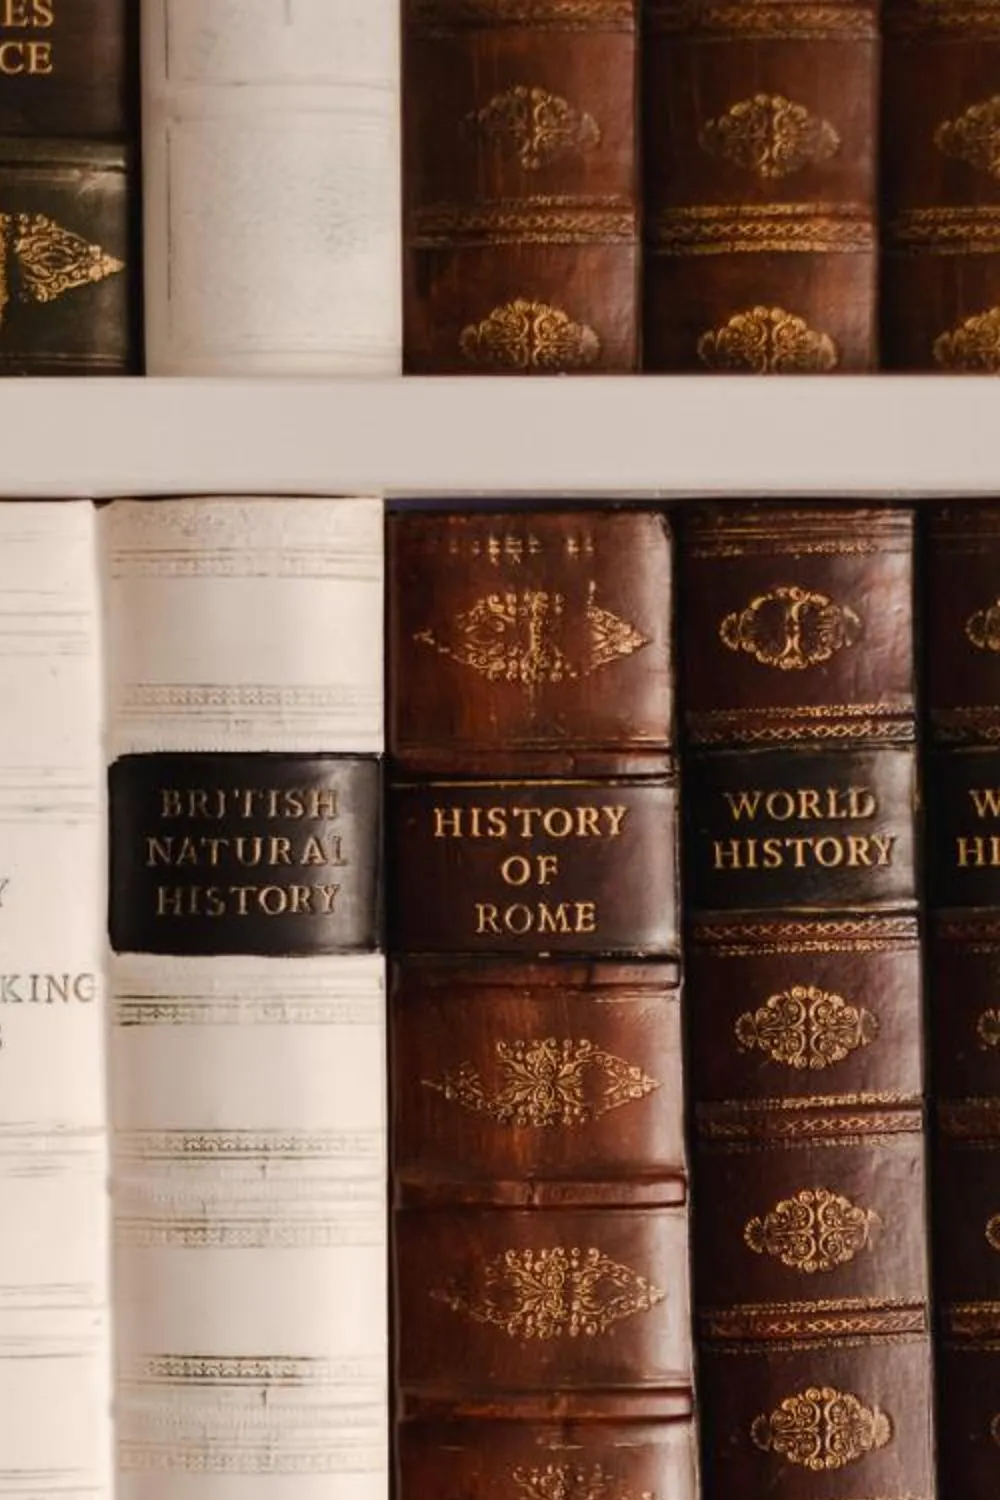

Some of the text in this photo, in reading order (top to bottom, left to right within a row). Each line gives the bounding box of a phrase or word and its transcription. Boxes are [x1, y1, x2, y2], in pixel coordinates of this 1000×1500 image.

[160, 788, 339, 819] BRITISH
[724, 787, 877, 821] WORLD
[433, 805, 627, 838] HISTORY
[147, 836, 348, 866] NATURAL
[713, 833, 895, 869] HISTORY
[956, 836, 1000, 867] HI
[501, 855, 559, 886] OF
[156, 884, 341, 916] HISTORY
[475, 902, 598, 934] ROME
